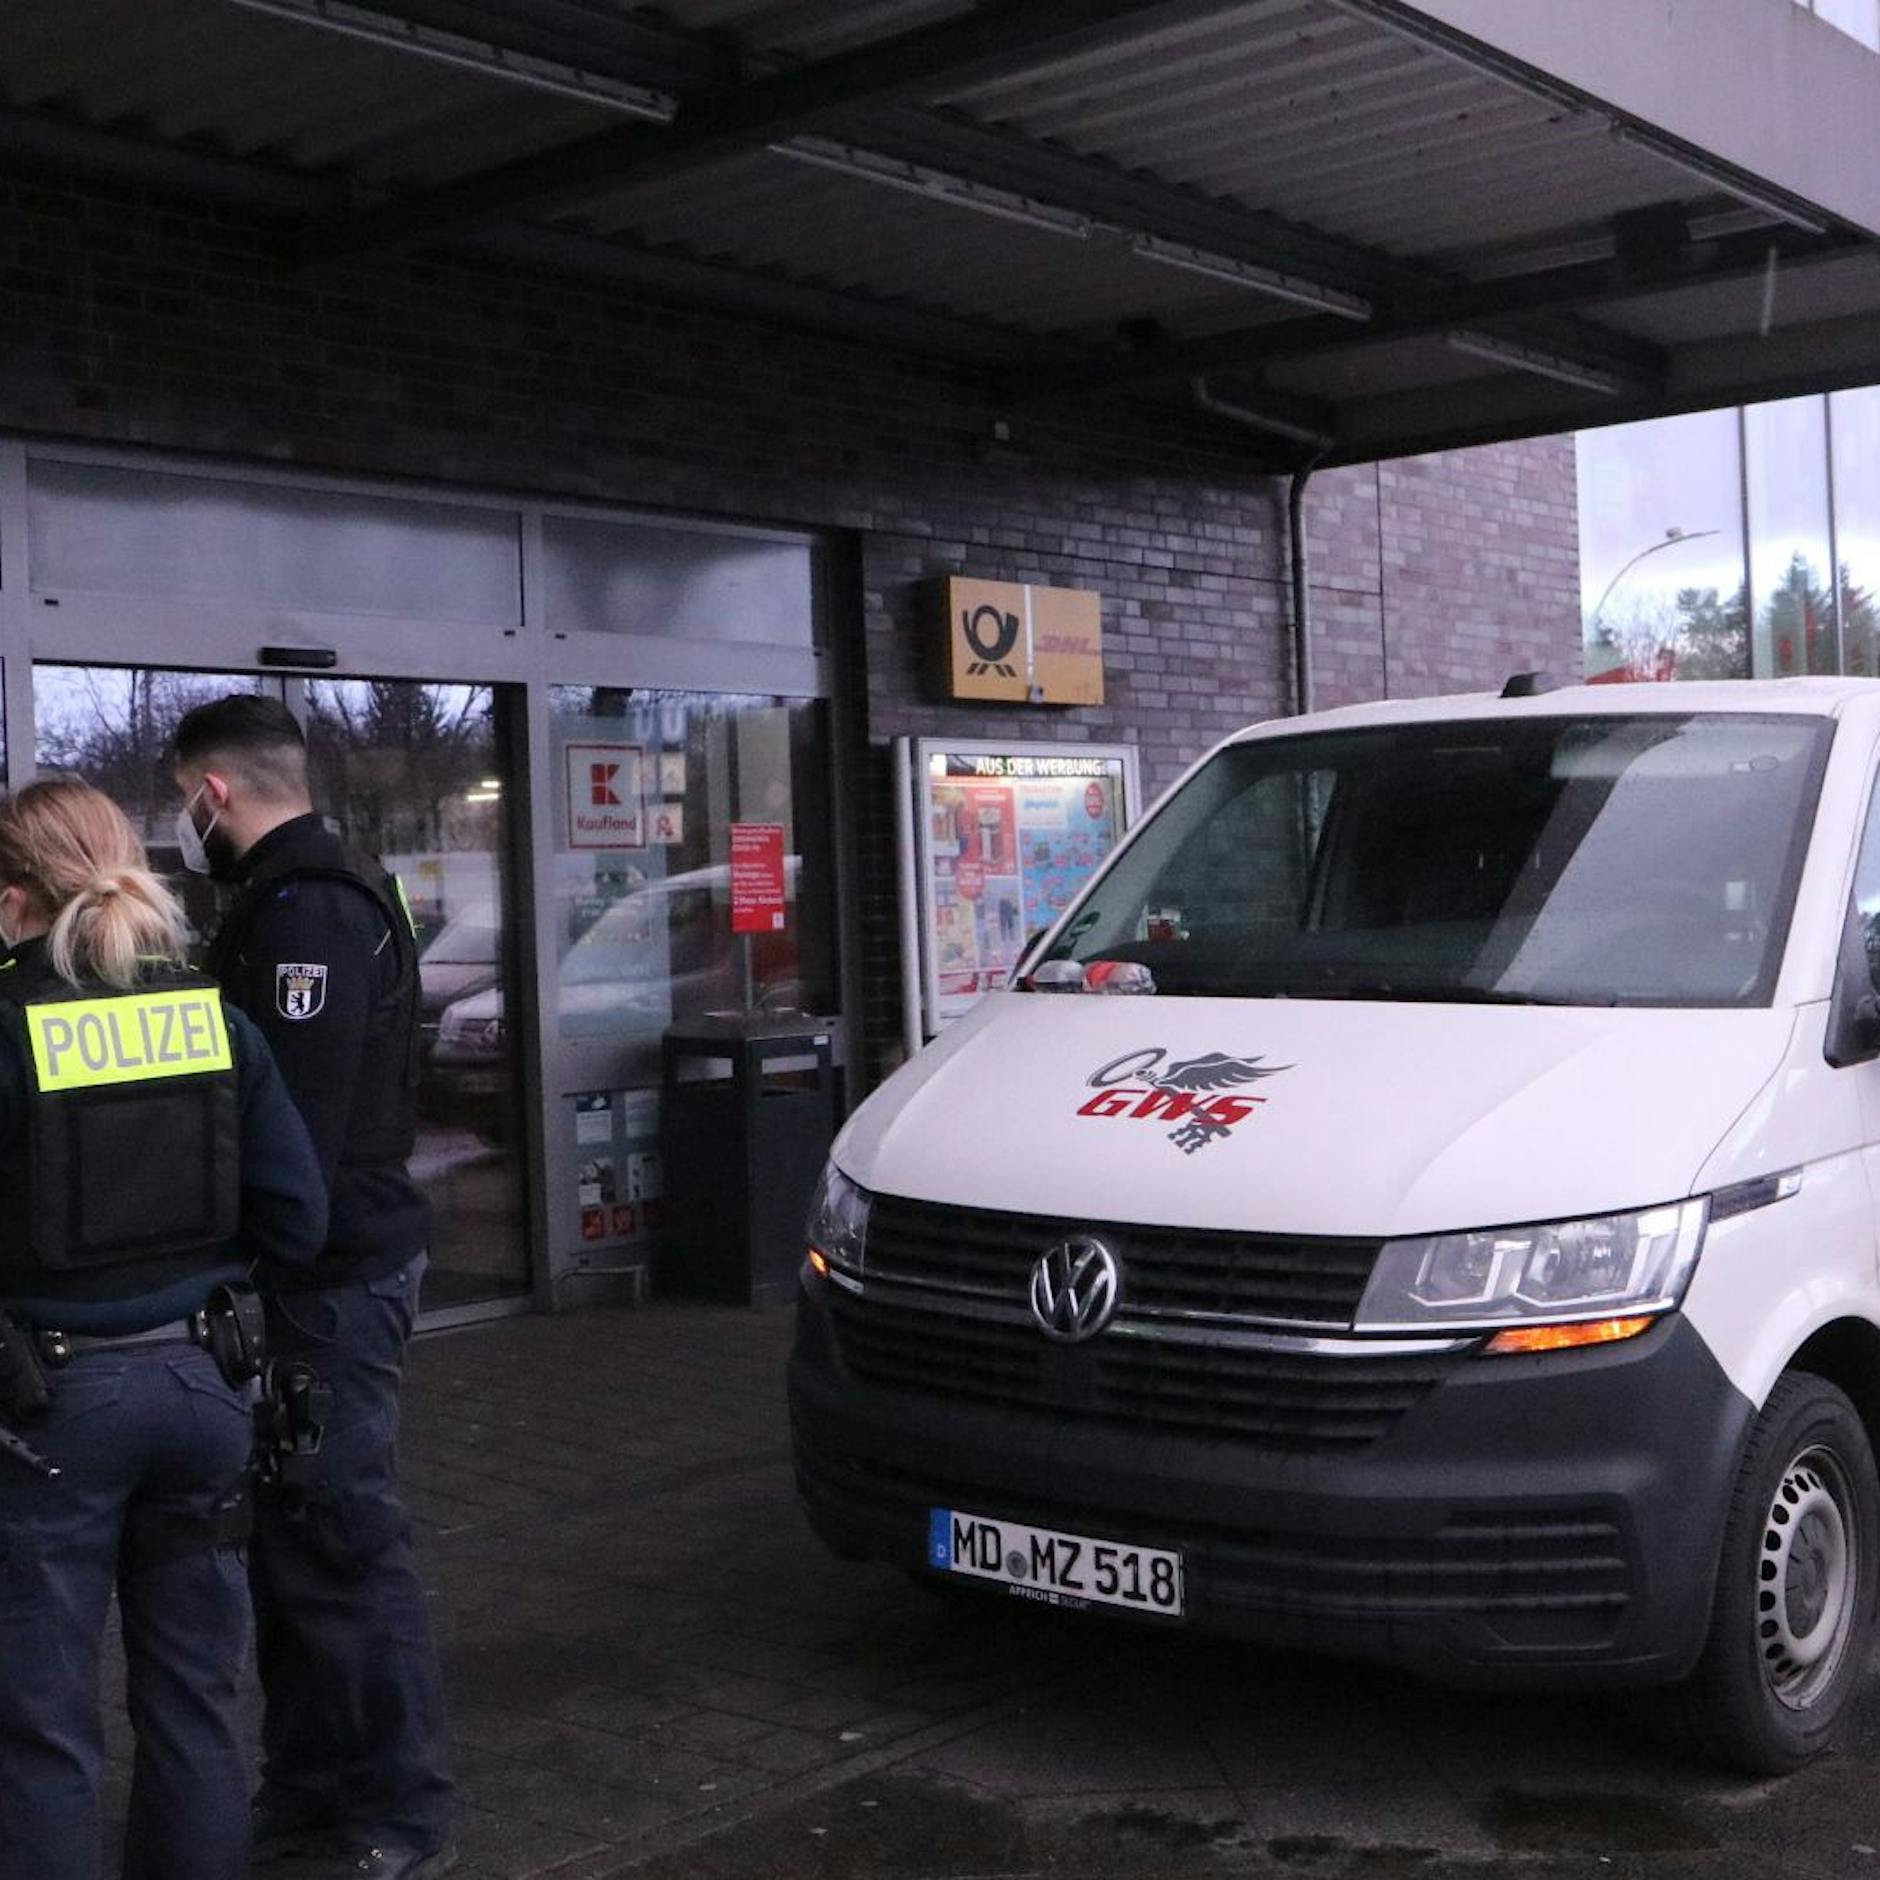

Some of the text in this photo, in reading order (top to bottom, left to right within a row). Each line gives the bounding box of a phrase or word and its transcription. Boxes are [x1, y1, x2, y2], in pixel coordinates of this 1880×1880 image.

[976, 757, 1101, 776] AUS DER WERBUNG
[591, 763, 622, 805] K
[577, 816, 637, 831] Kaufland
[279, 966, 323, 978] POLIZEI
[42, 1002, 219, 1076] POLIZEI
[1076, 1089, 1268, 1125] GWS
[937, 1545, 946, 1558] D
[953, 1518, 1176, 1606] MD MZ 518
